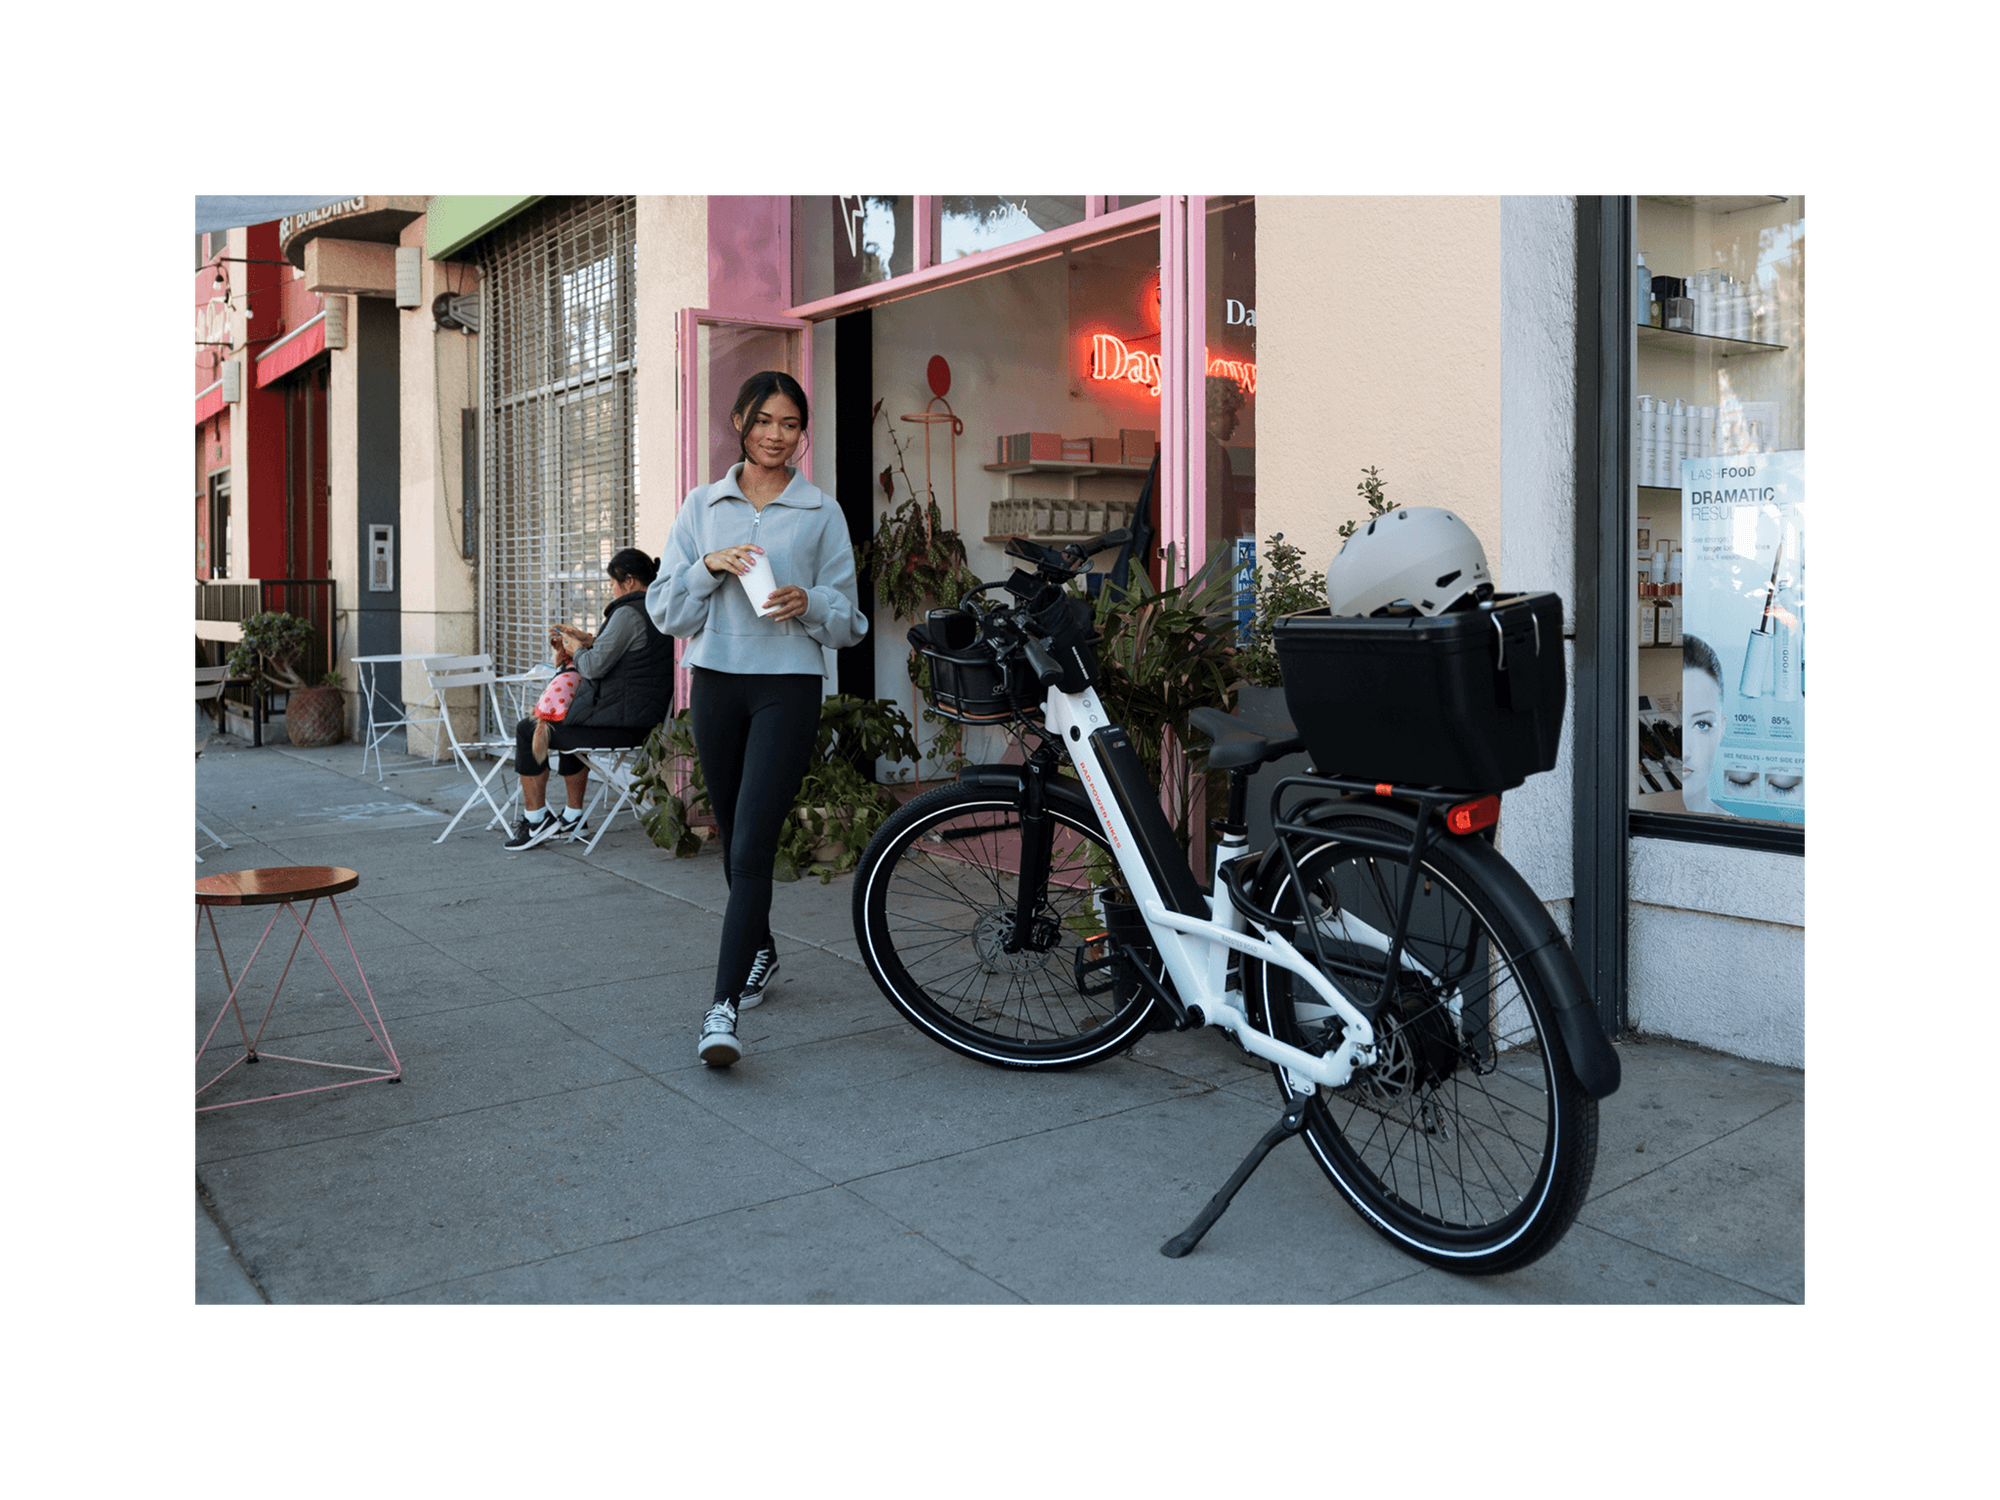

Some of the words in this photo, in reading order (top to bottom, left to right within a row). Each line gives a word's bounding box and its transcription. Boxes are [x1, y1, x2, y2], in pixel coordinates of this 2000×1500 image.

[989, 199, 1029, 233] 3206
[1691, 466, 1756, 481] LASHFOOD
[1691, 486, 1775, 505] DRAMATIC
[1691, 504, 1754, 521] RESUL
[1703, 545, 1722, 553] longer
[1734, 714, 1756, 723] 100%
[1771, 716, 1791, 725] 85%
[1735, 753, 1760, 761] RESULTS
[1080, 762, 1092, 782] RAD
[1090, 783, 1108, 818] POWER
[1106, 820, 1121, 849] BIKES
